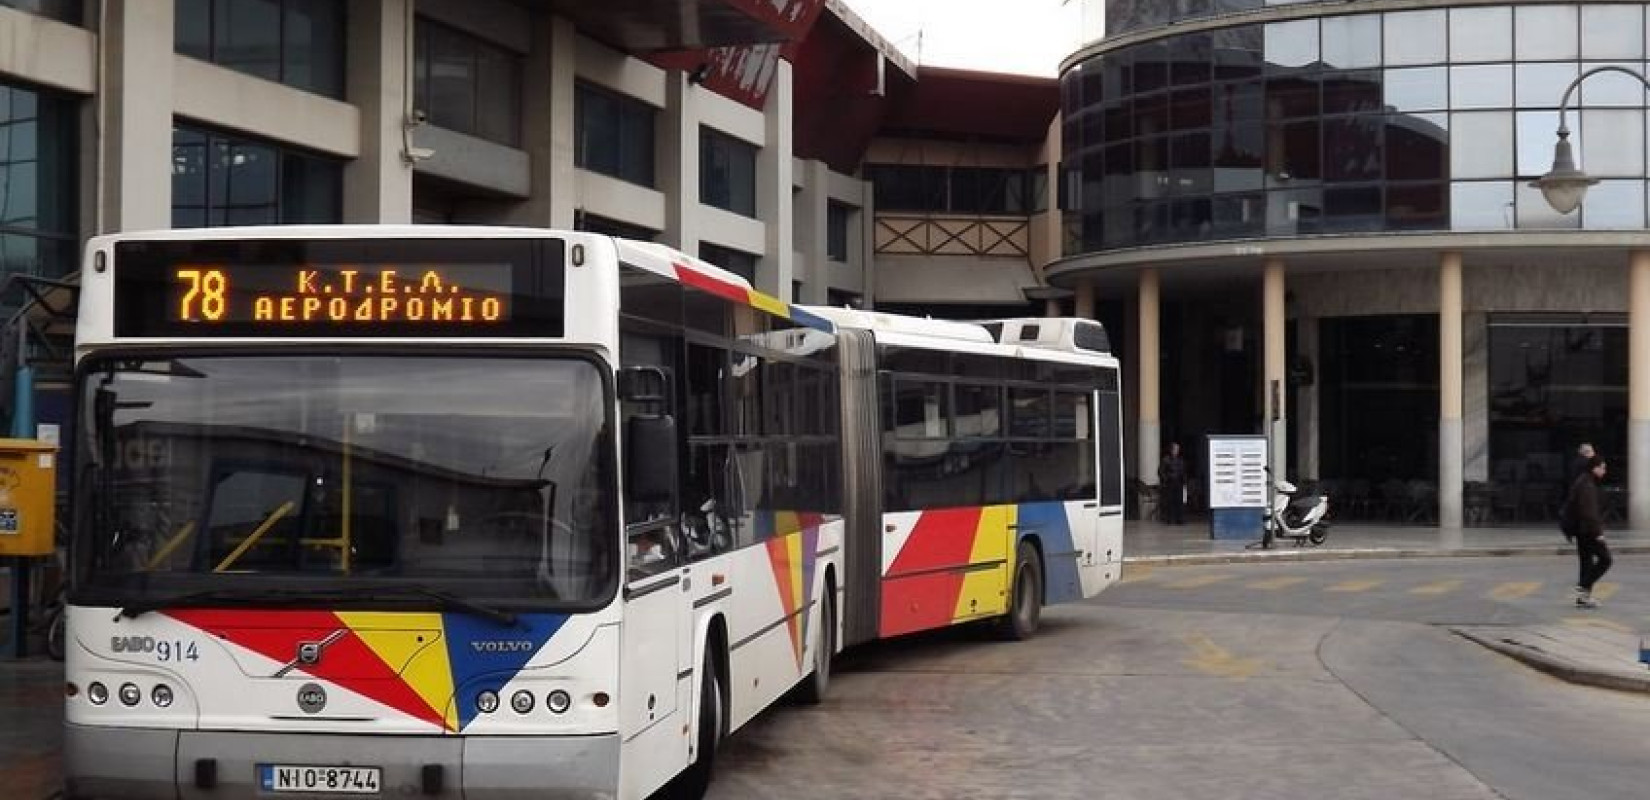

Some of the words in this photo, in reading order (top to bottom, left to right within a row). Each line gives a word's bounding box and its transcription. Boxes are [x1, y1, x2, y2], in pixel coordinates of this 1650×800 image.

[177, 270, 226, 320] 78
[254, 297, 499, 321] ΑΕΡΟΔΡΟΜΙΟ
[156, 640, 199, 662] 914
[470, 640, 533, 652] VOLVO
